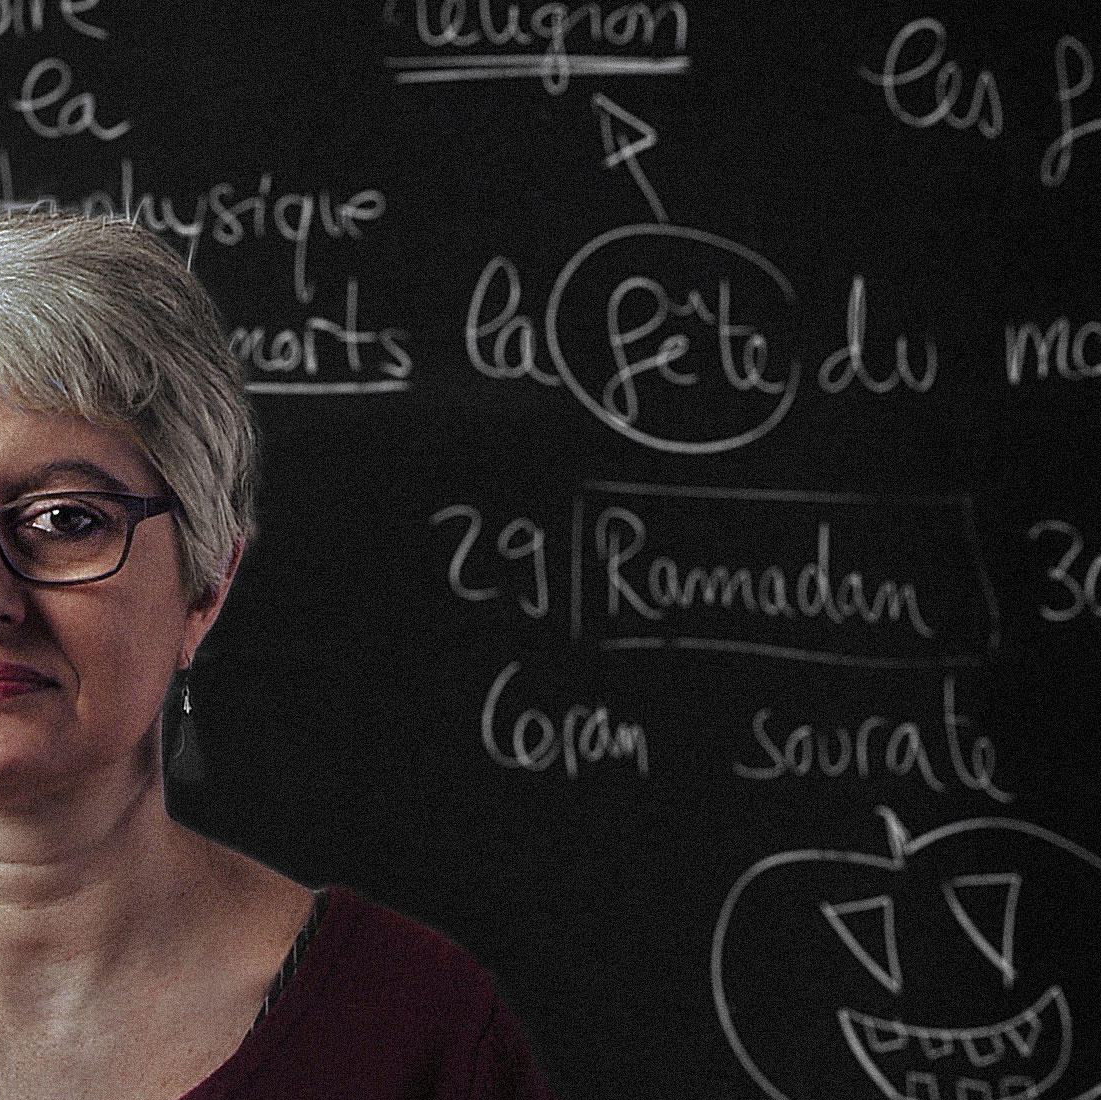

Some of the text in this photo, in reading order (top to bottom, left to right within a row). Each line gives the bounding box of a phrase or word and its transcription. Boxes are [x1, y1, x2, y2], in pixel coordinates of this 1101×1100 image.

[12, 58, 131, 141] la
[465, 254, 562, 386] la
[599, 275, 788, 424] fête
[818, 275, 938, 394] du
[432, 504, 549, 618] 29
[595, 507, 934, 638] Ramadan
[731, 674, 1015, 802] sourate
